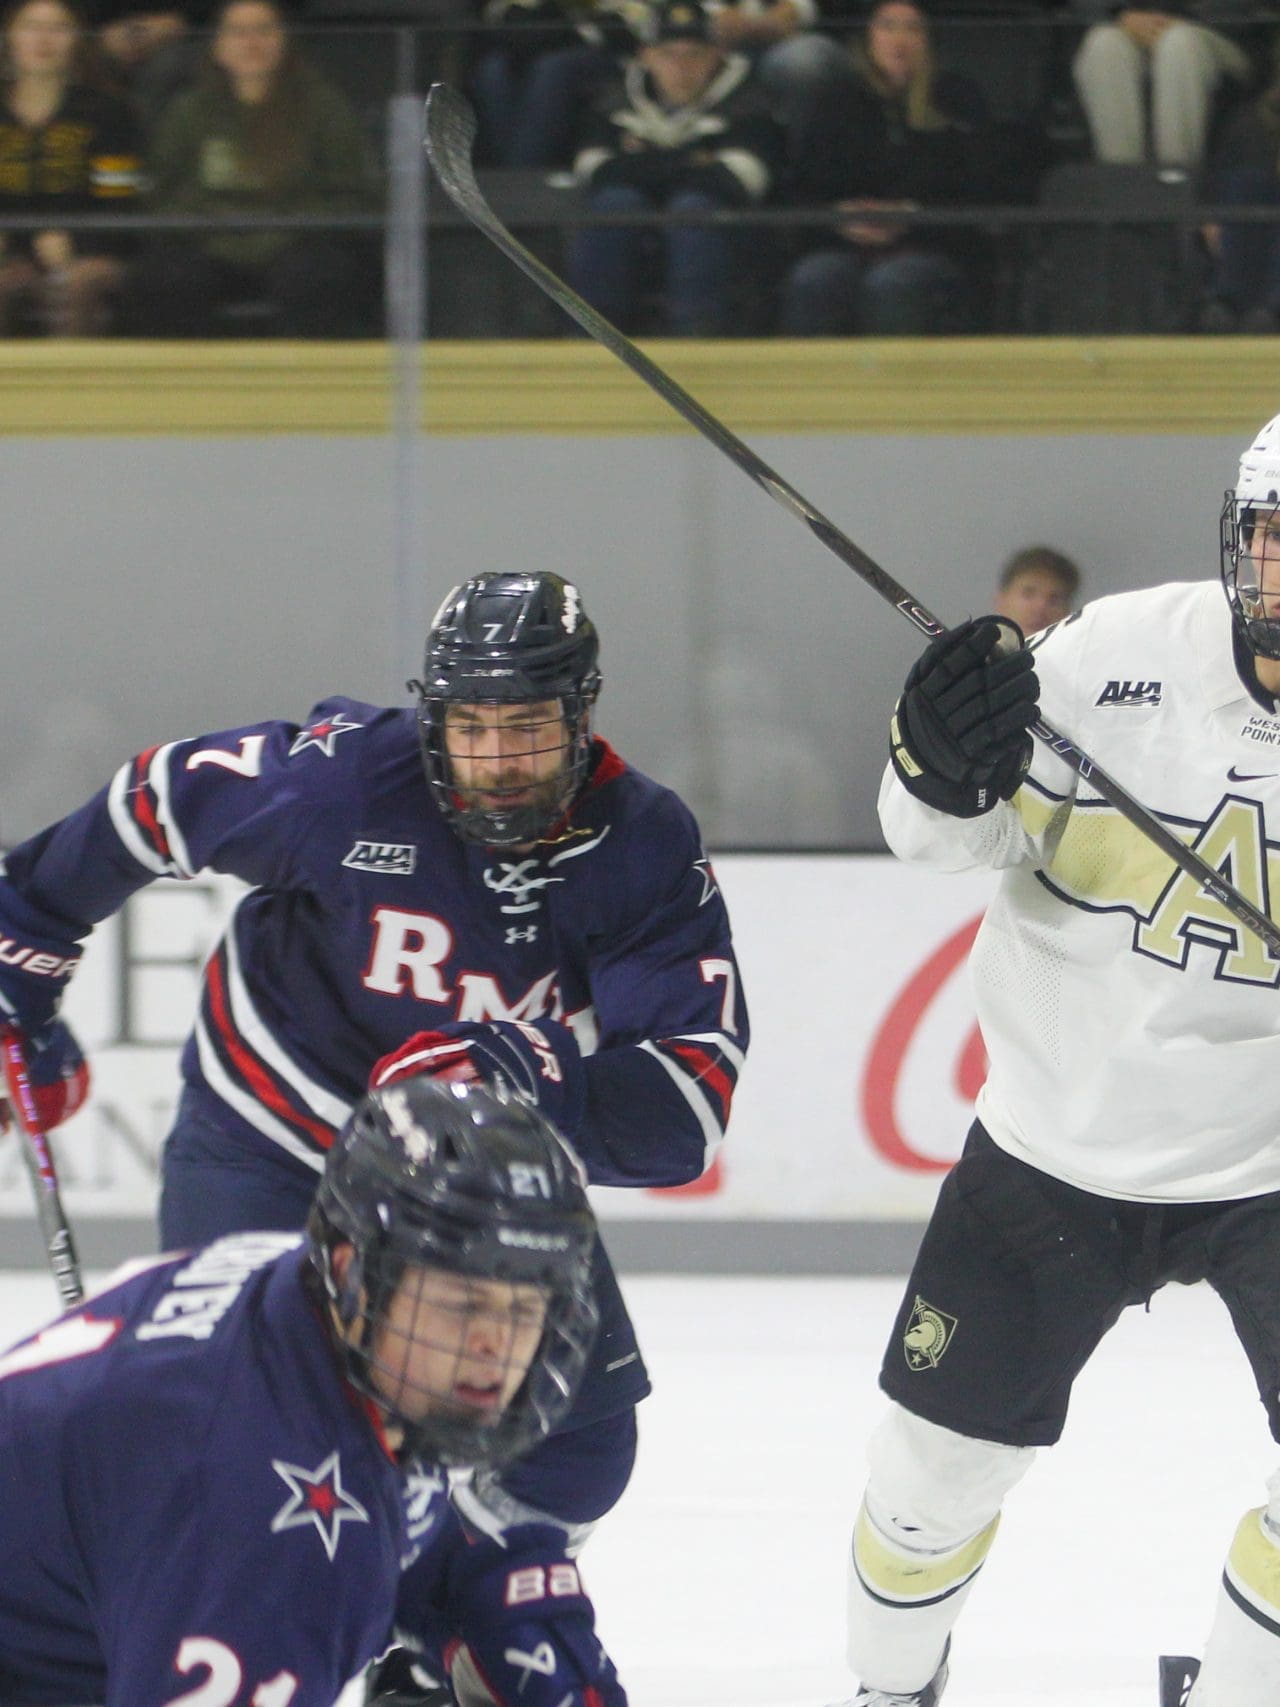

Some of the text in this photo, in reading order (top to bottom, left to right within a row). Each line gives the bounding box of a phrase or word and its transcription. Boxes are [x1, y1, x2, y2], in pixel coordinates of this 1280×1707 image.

[482, 623, 503, 642] 7
[1095, 680, 1162, 707] AHA
[345, 843, 414, 873] AHA
[699, 957, 739, 1038] 7
